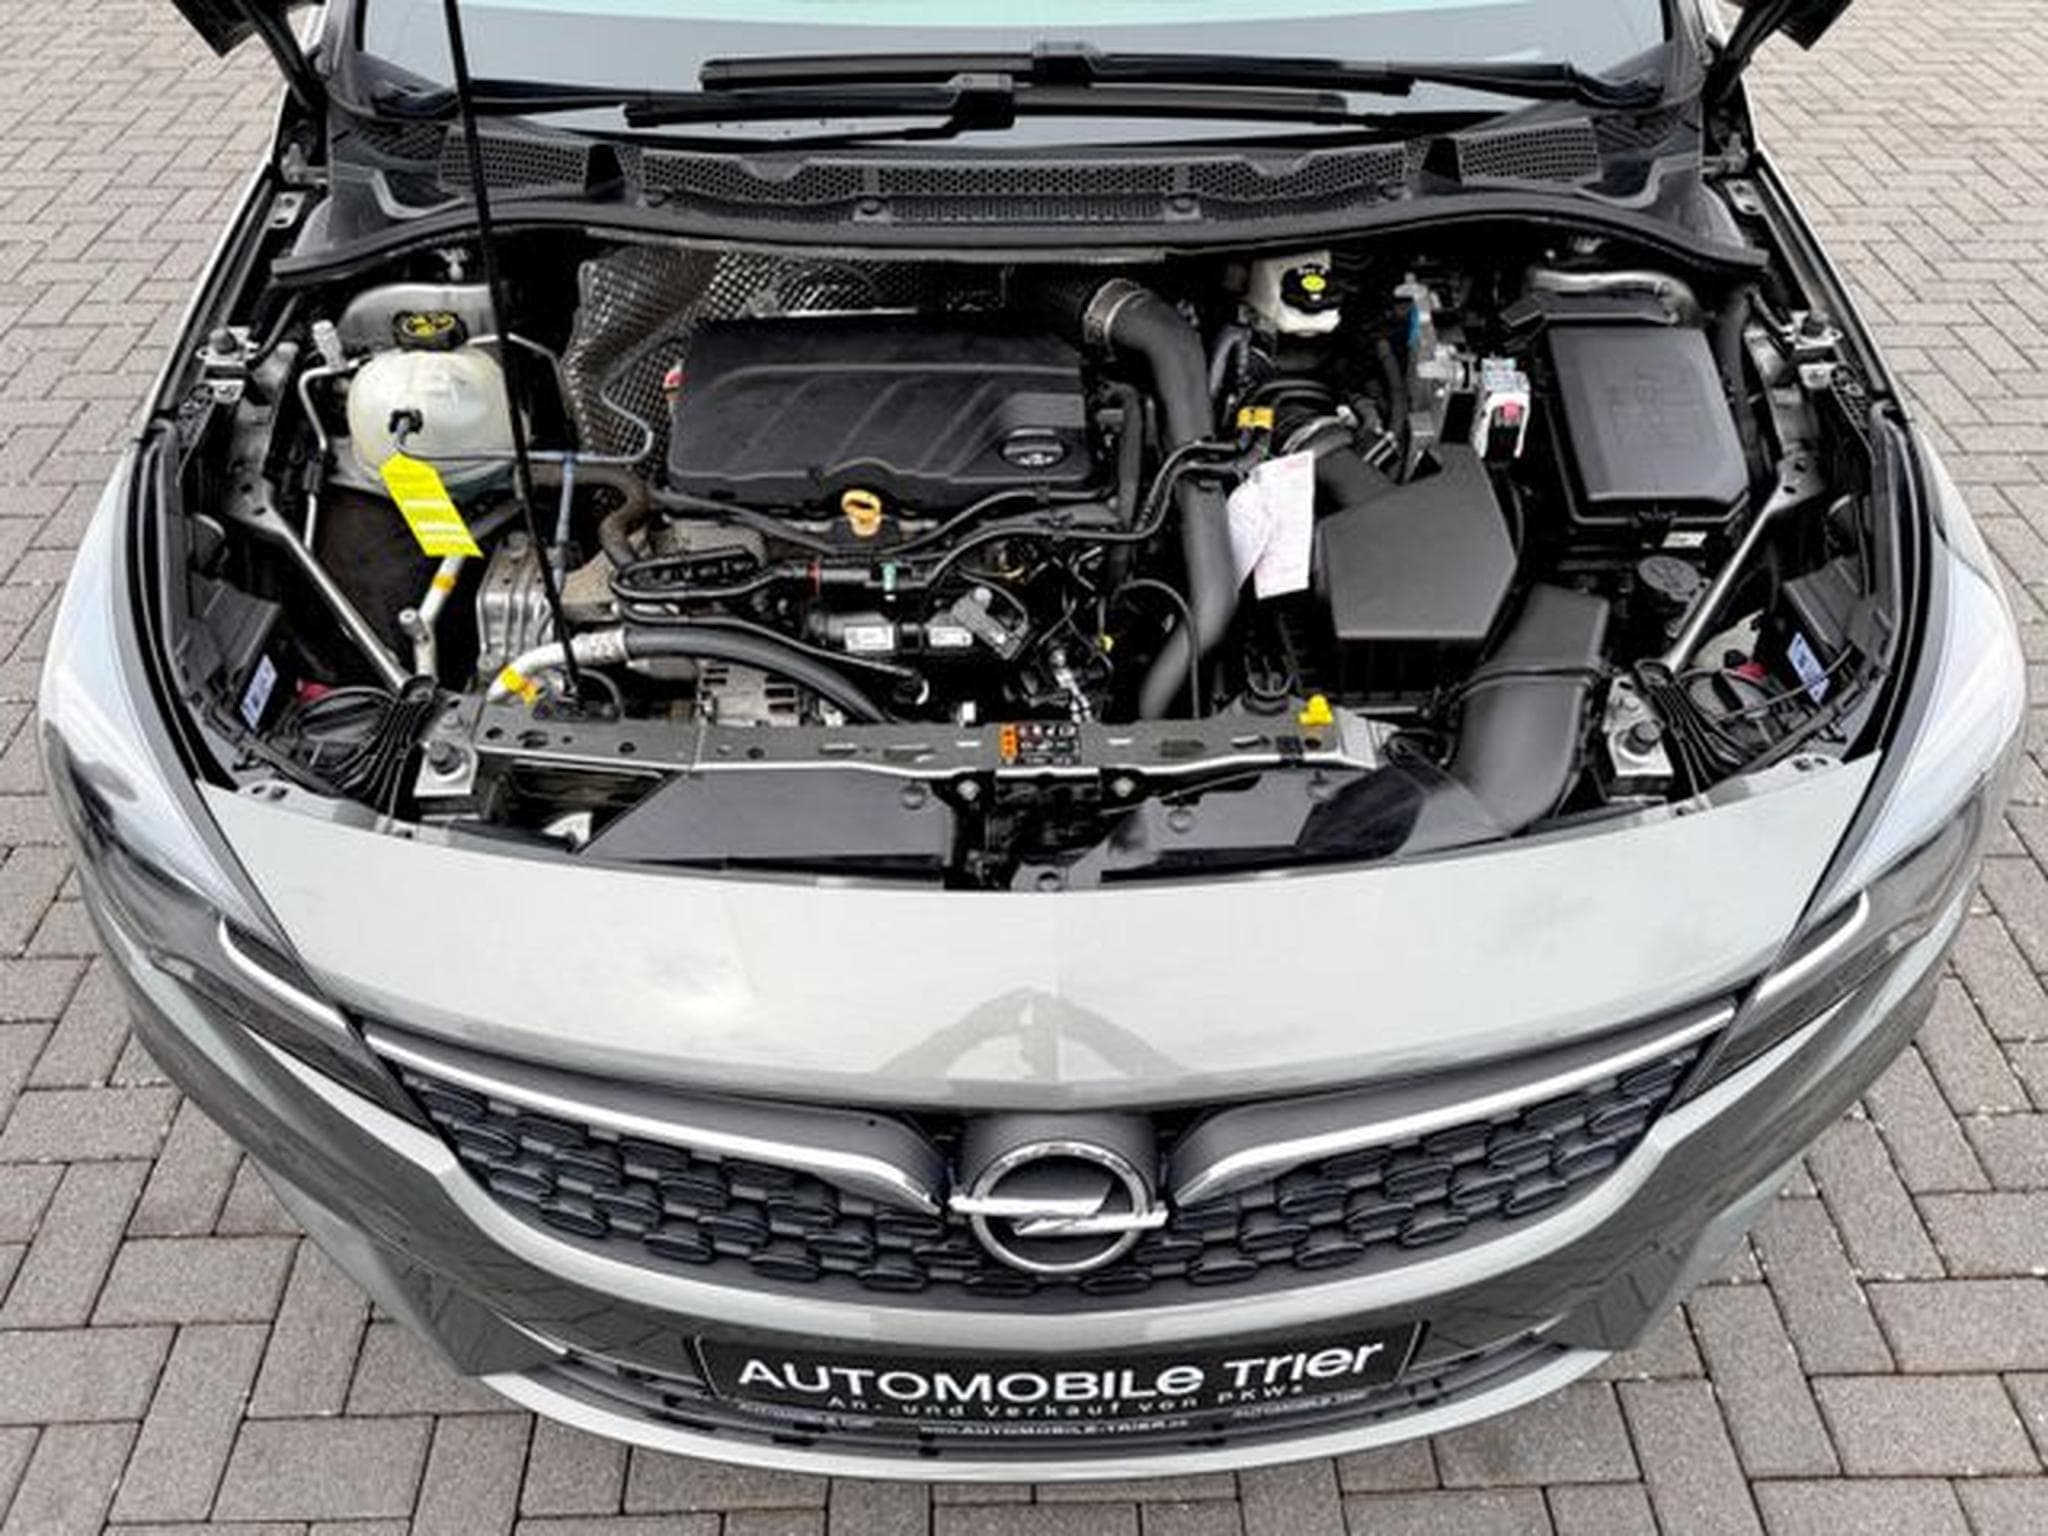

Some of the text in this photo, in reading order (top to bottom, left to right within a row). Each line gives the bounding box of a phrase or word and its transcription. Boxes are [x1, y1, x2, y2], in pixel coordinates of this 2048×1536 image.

[902, 1404, 965, 1417] und
[983, 1400, 1120, 1418] Verkauf
[1138, 1397, 1198, 1413] von
